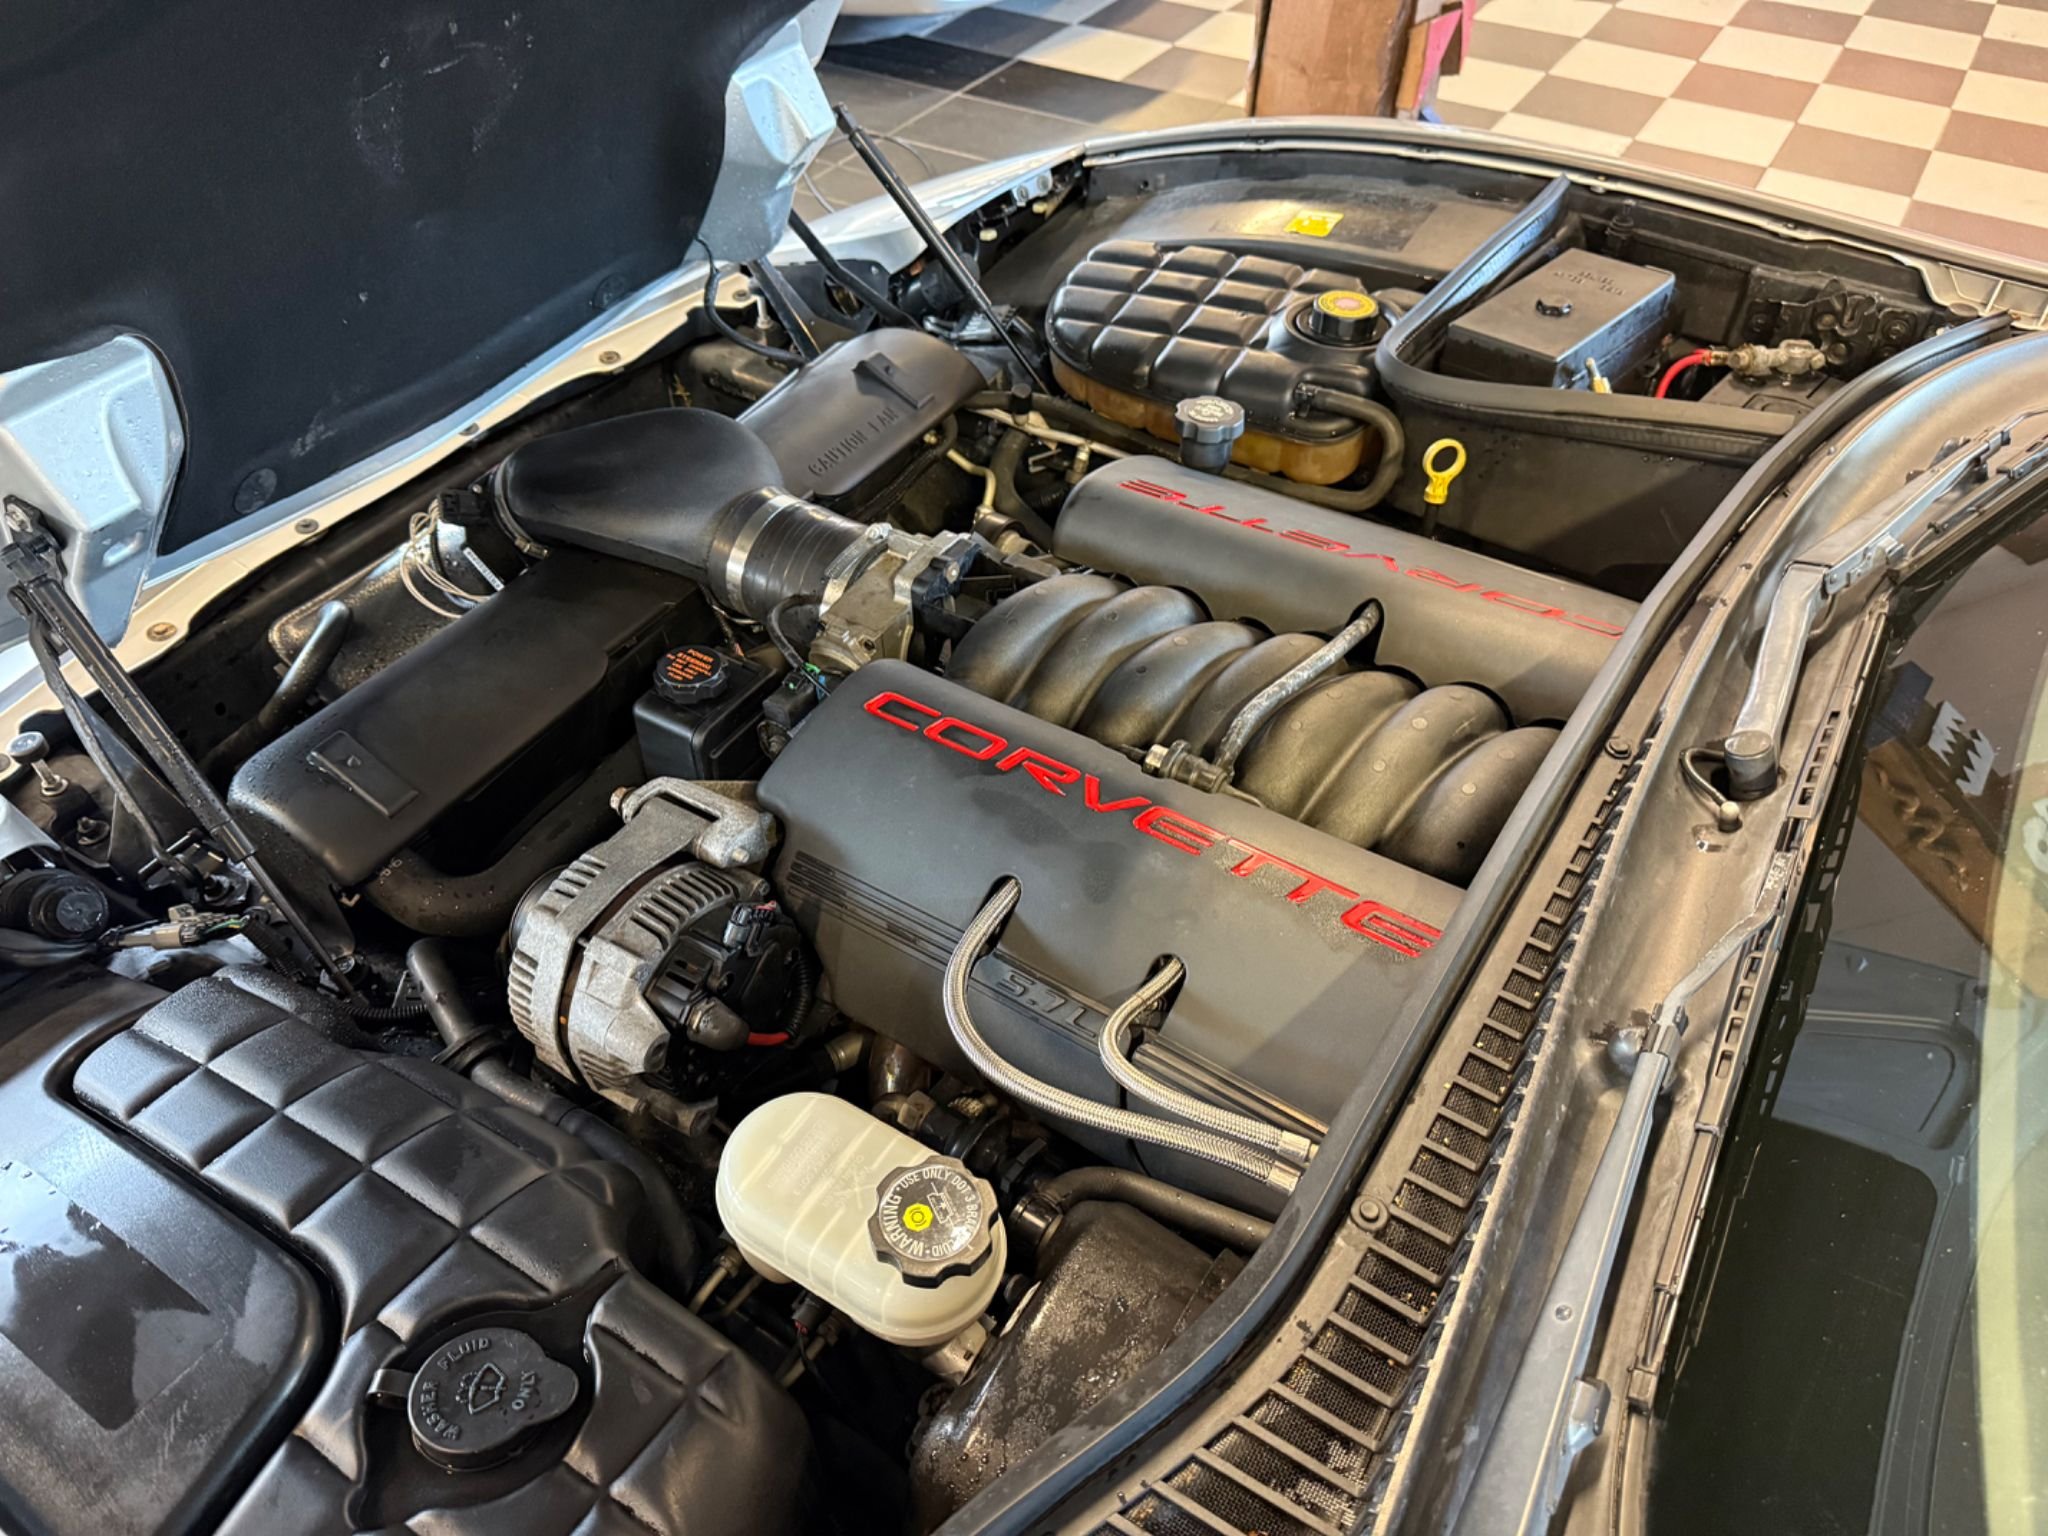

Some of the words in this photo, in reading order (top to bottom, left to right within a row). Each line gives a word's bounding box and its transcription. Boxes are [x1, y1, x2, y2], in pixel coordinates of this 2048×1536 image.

[808, 429, 868, 477] CAUTION
[1120, 478, 1625, 640] CORVETTE
[863, 691, 1444, 959] CORVETTE
[996, 968, 1097, 1039] 5.7L
[900, 1172, 921, 1189] USE
[922, 1167, 953, 1181] ONLY
[951, 1175, 972, 1194] DOT
[964, 1193, 977, 1203] 3
[882, 1193, 924, 1257] WARNING
[437, 1337, 490, 1371] FLUID
[420, 1380, 461, 1441] WASHER
[512, 1370, 537, 1410] ONLY
